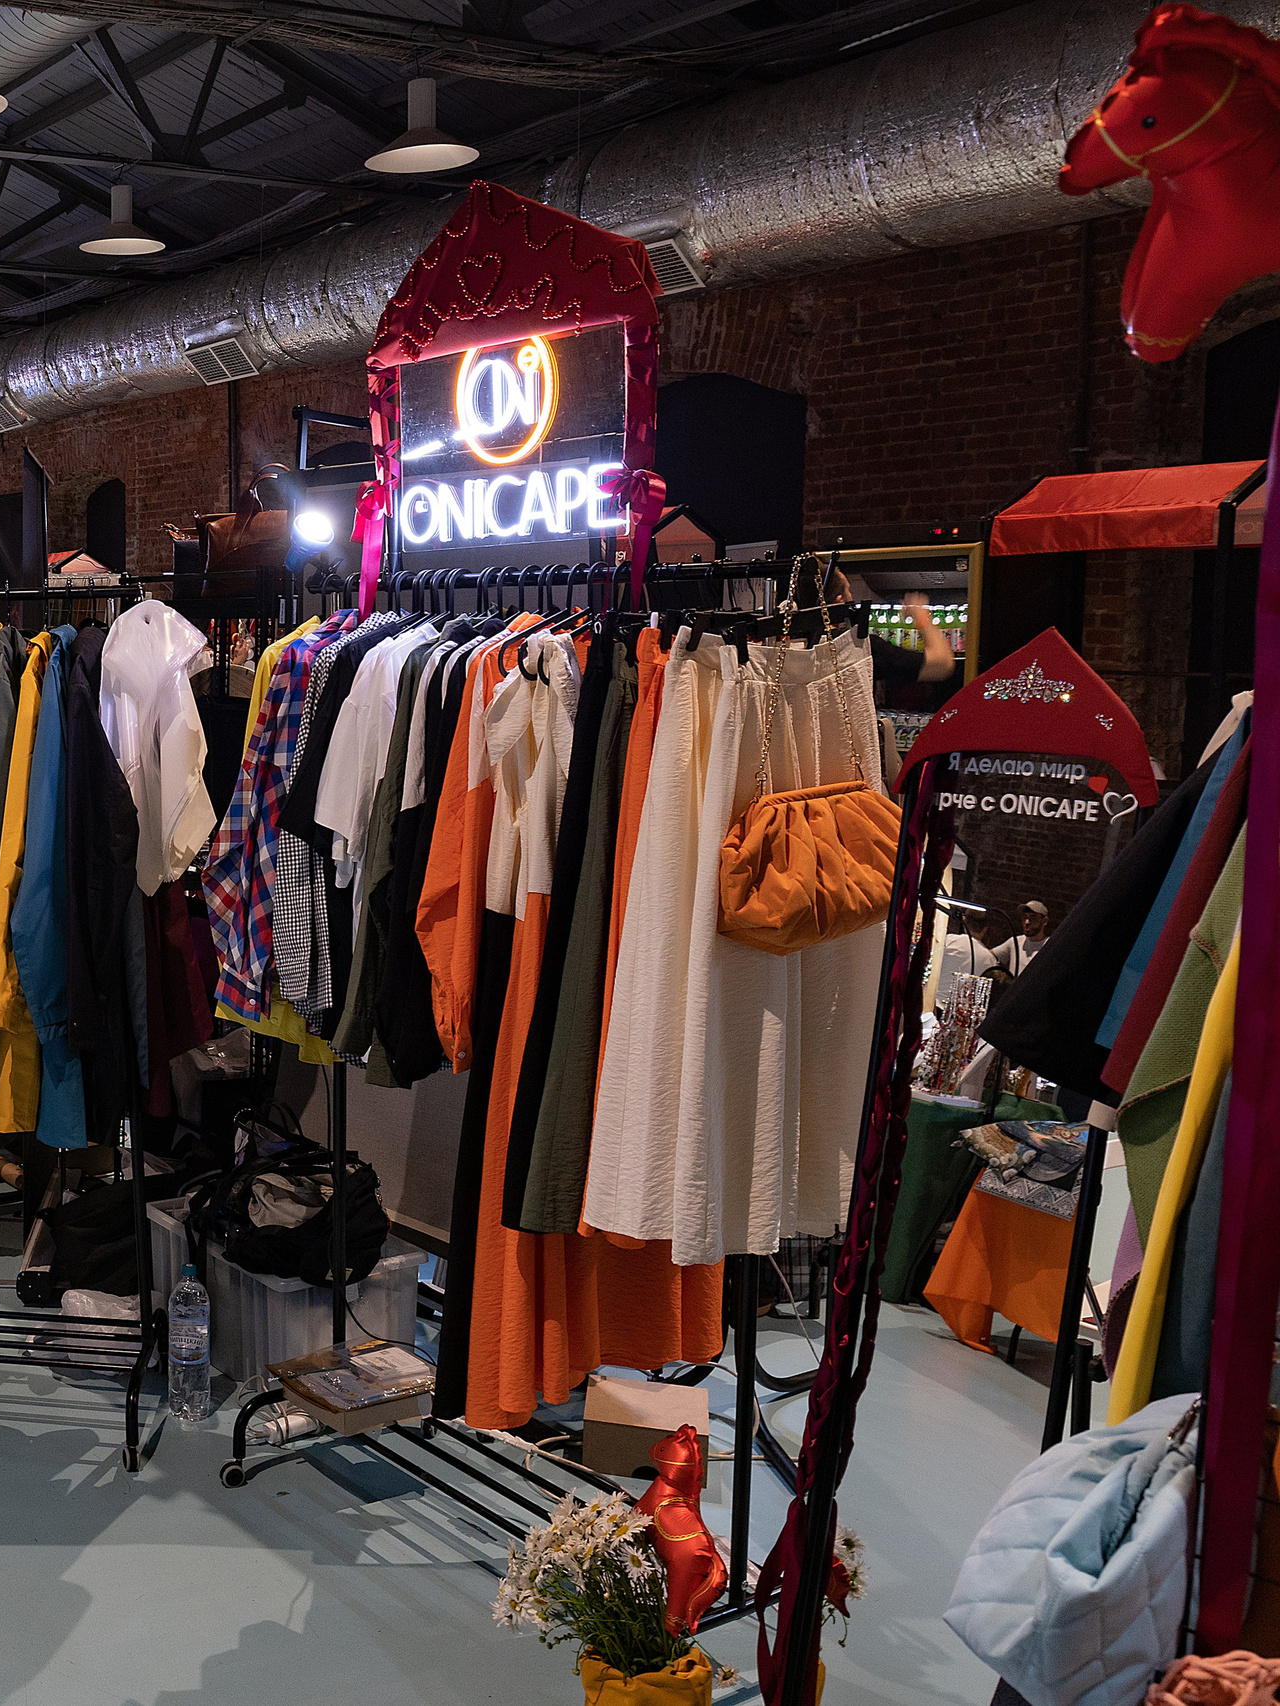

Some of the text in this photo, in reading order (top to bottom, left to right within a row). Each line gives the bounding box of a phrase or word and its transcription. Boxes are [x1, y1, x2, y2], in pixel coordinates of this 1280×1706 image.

[400, 462, 630, 543] ONICAPE
[948, 752, 1086, 784] Я делаю мир
[999, 793, 1100, 822] ONICAPE
